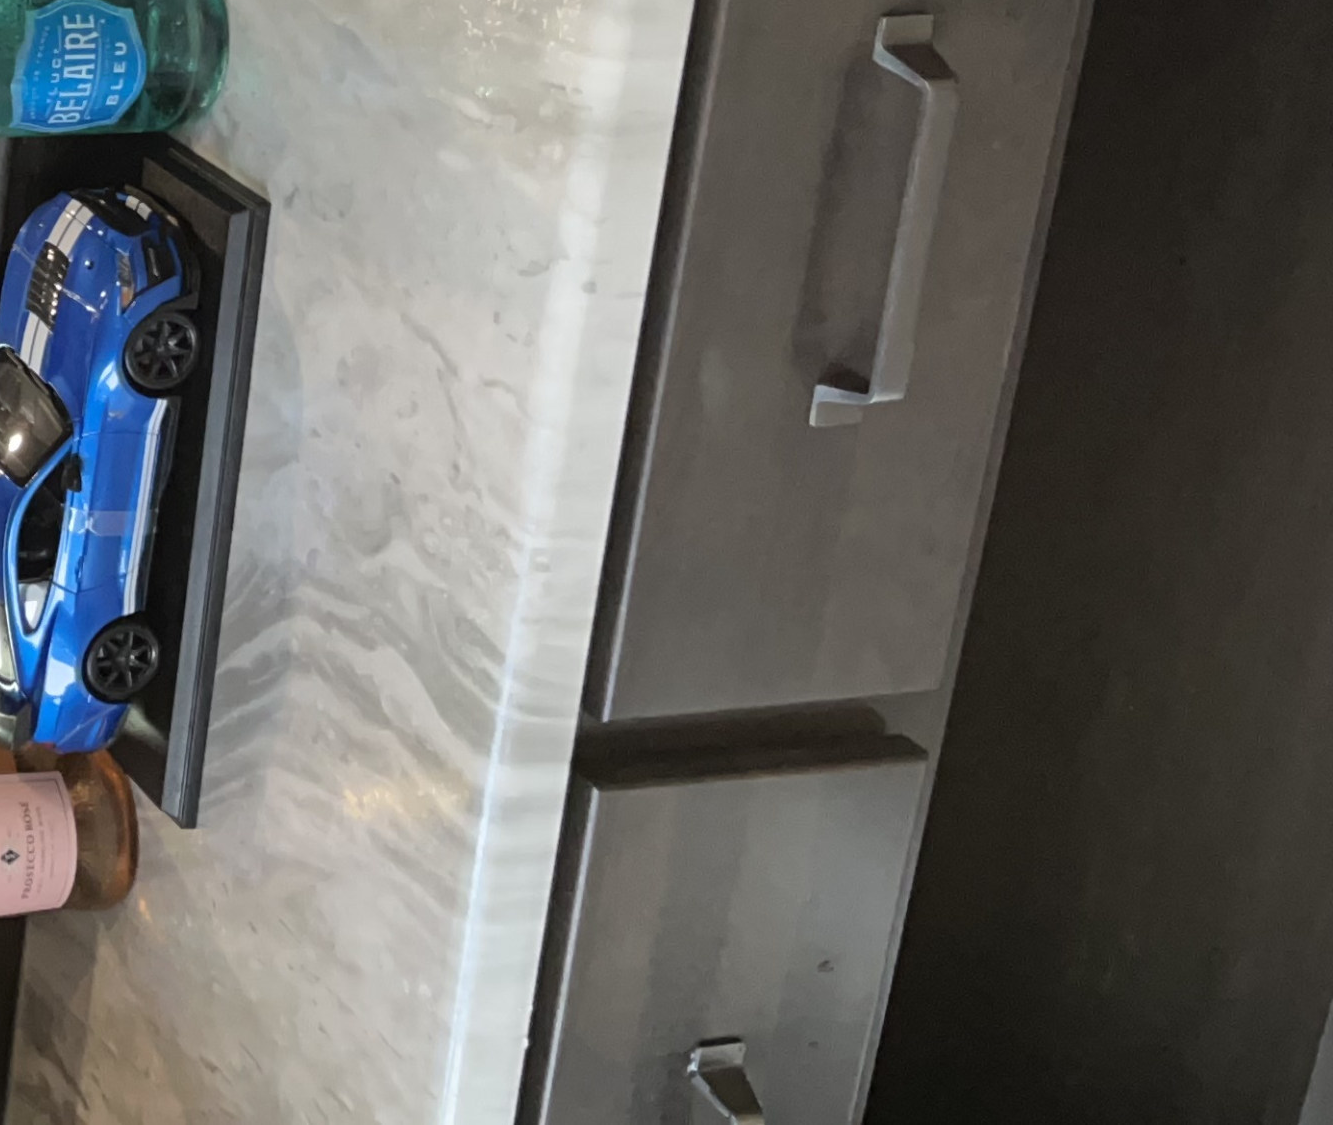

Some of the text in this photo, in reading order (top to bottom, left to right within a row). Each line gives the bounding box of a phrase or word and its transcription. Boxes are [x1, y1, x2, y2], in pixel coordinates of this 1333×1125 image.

[47, 13, 99, 124] BELAIRE
[105, 42, 127, 105] BLEU
[20, 834, 36, 899] PROSECCO
